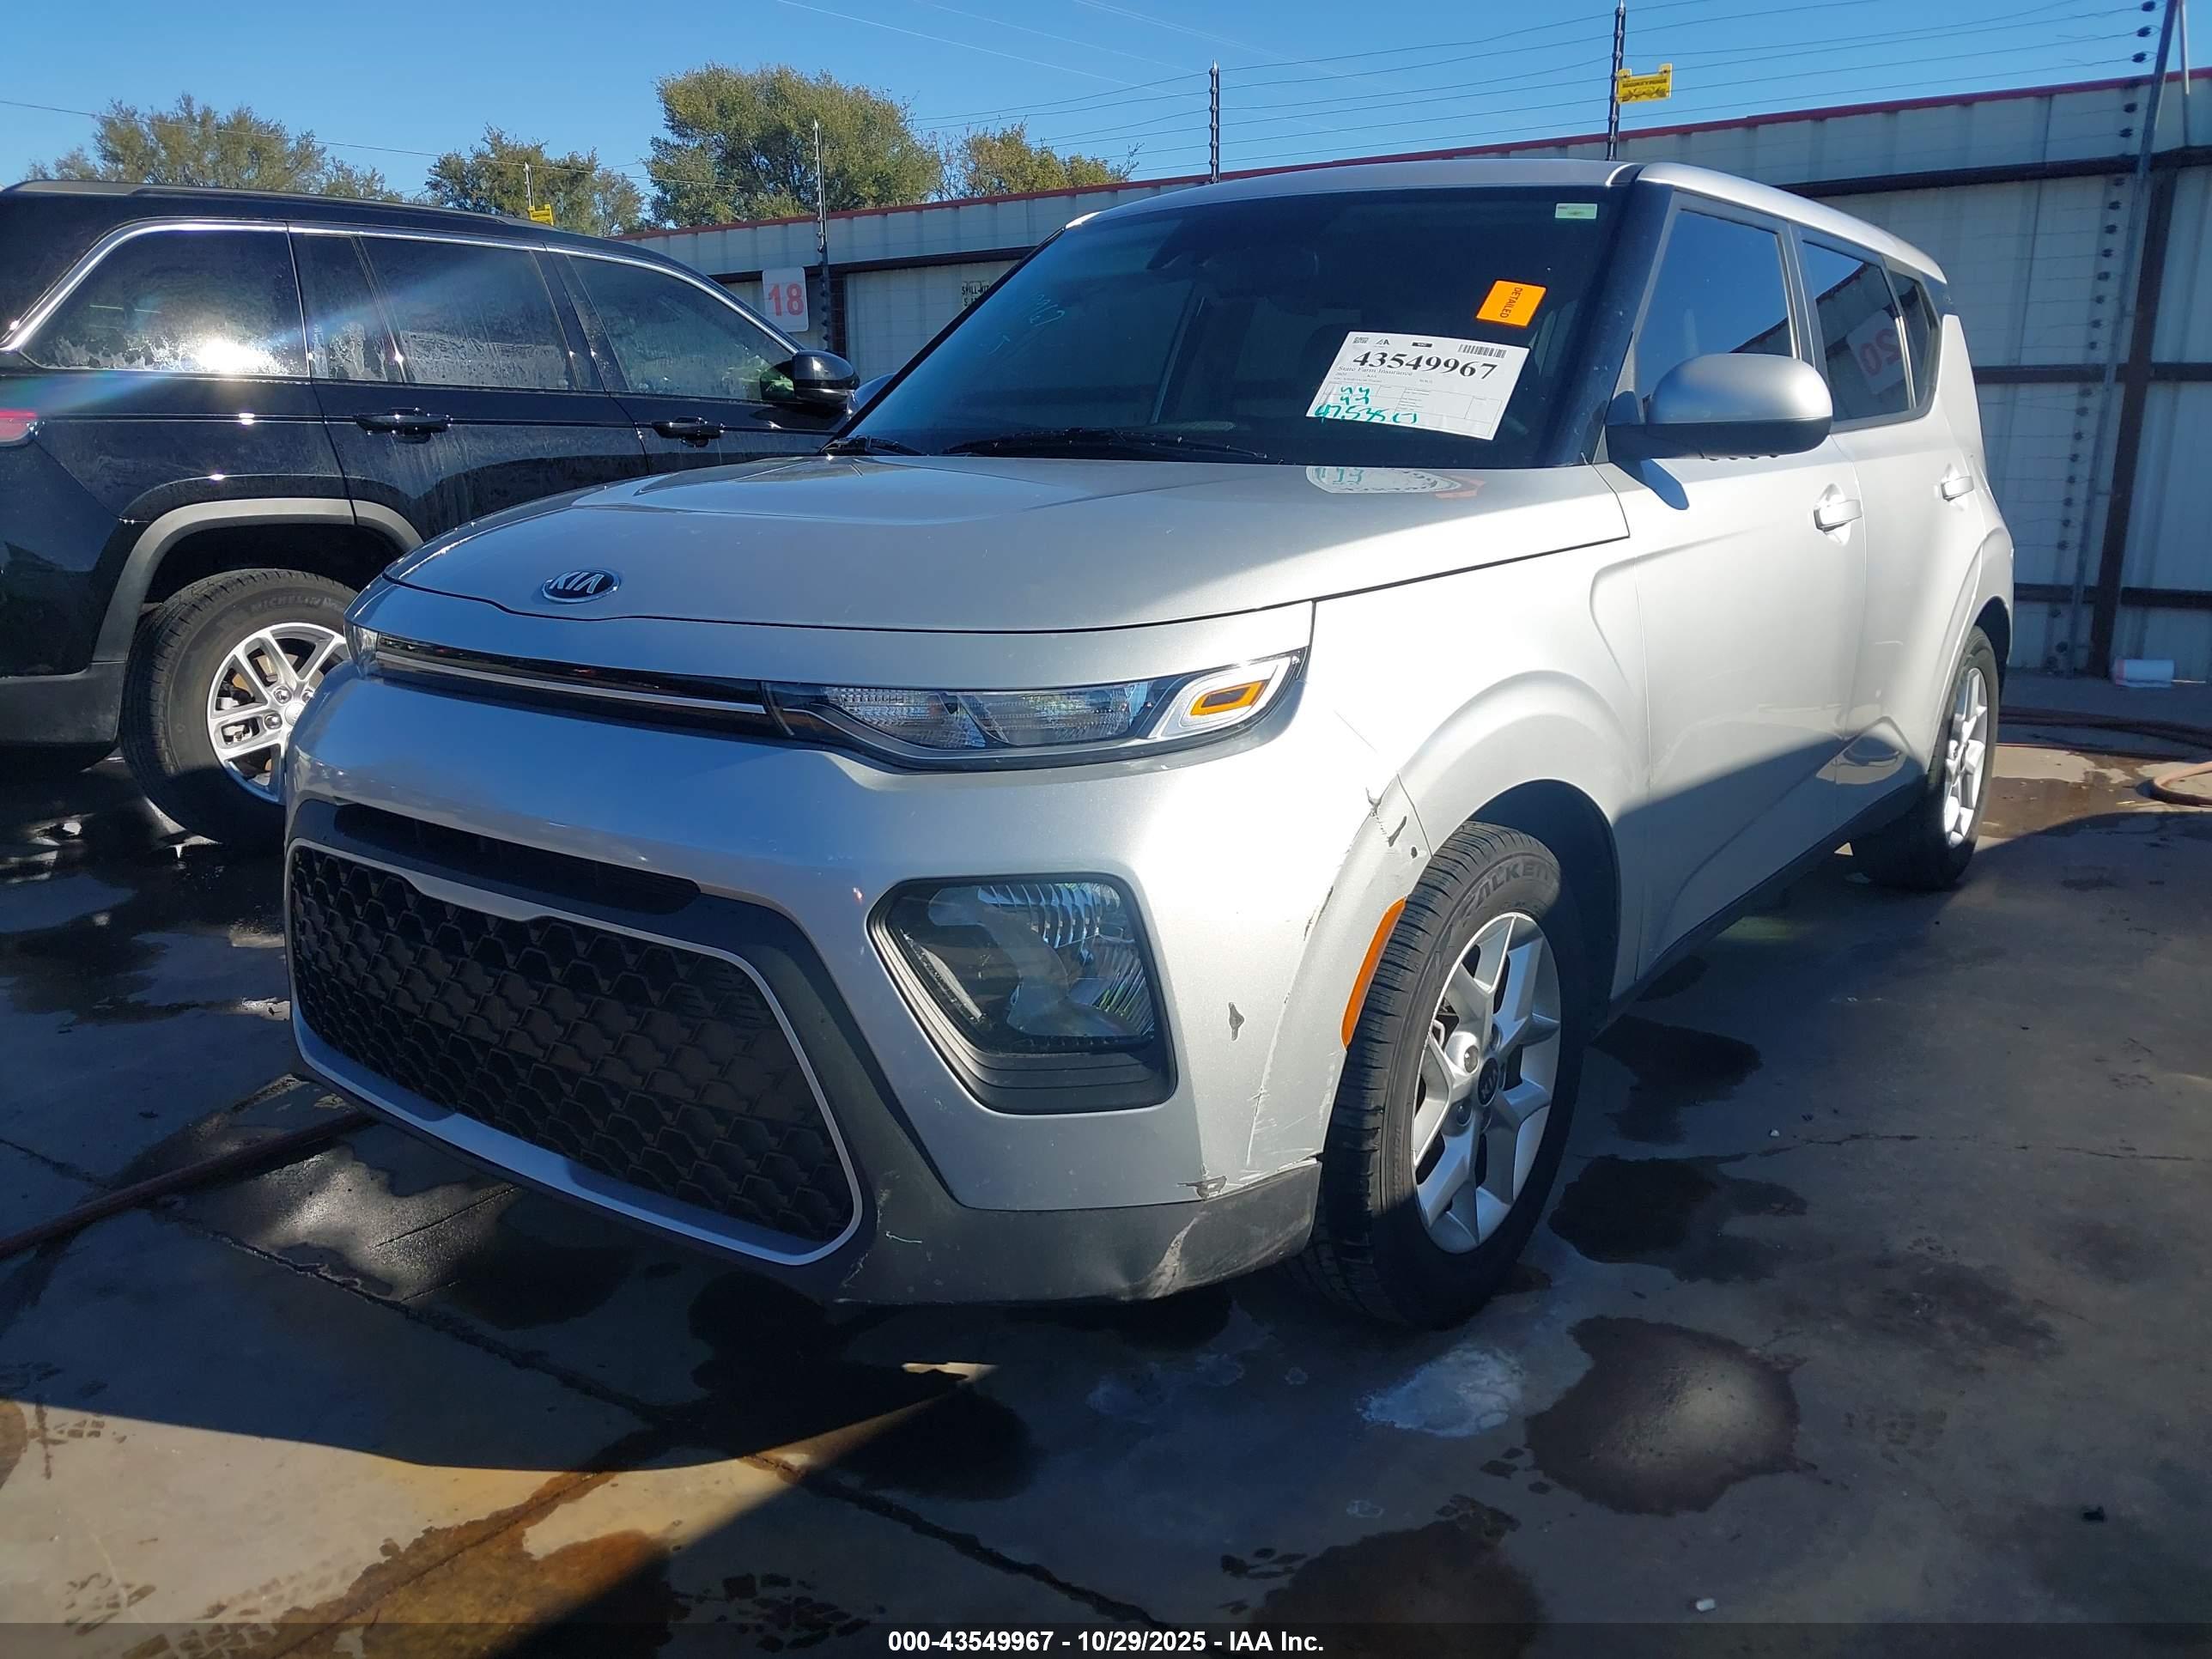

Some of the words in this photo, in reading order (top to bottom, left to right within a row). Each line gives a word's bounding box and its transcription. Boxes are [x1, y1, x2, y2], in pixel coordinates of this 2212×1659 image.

[769, 283, 805, 317] 18
[1499, 287, 1523, 319] DETAILED
[1353, 350, 1498, 380] 43549967
[550, 571, 605, 594] KIA
